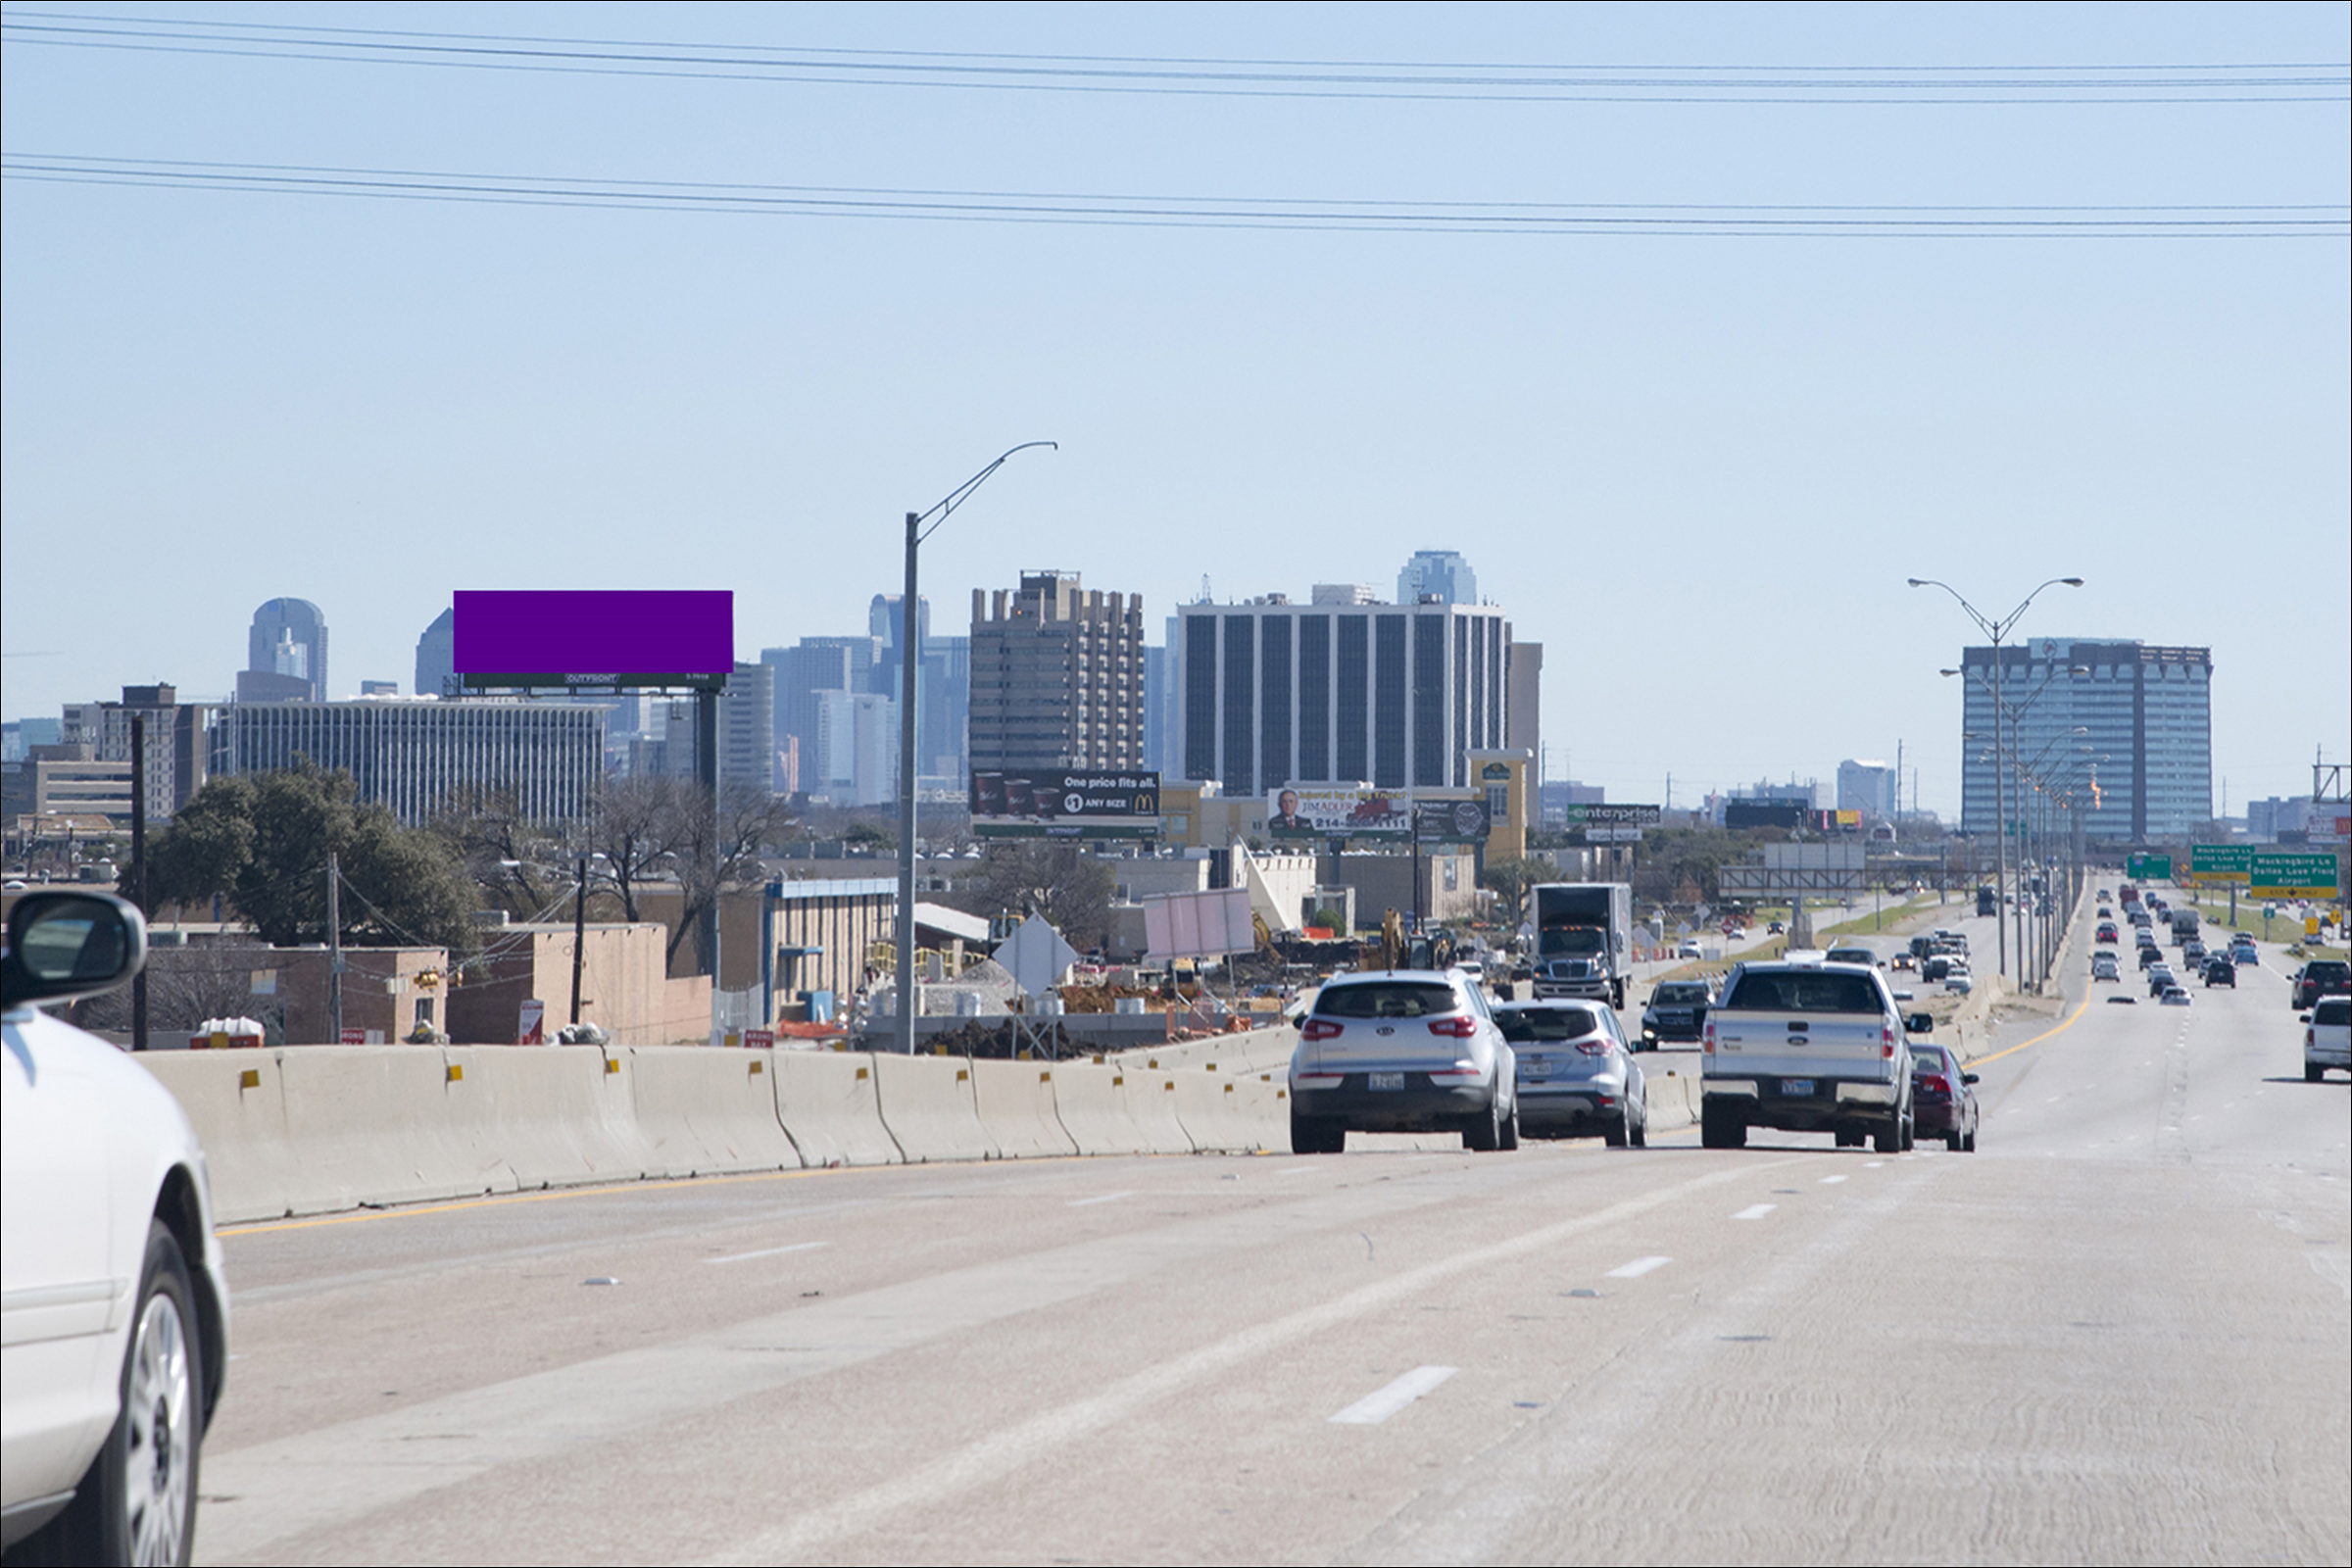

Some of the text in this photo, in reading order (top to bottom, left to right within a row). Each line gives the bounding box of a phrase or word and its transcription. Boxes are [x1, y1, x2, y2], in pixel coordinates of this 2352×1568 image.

[1064, 776, 1156, 789] One price fits all.
[1298, 790, 1332, 801] Injured
[1334, 790, 1346, 801] by
[1085, 799, 1104, 808] ANY
[1105, 799, 1127, 808] SIZE
[1302, 802, 1319, 812] JIM
[1573, 808, 1658, 820] enterprise
[2257, 857, 2315, 866] Mockingbird
[2278, 877, 2311, 886] Airport
